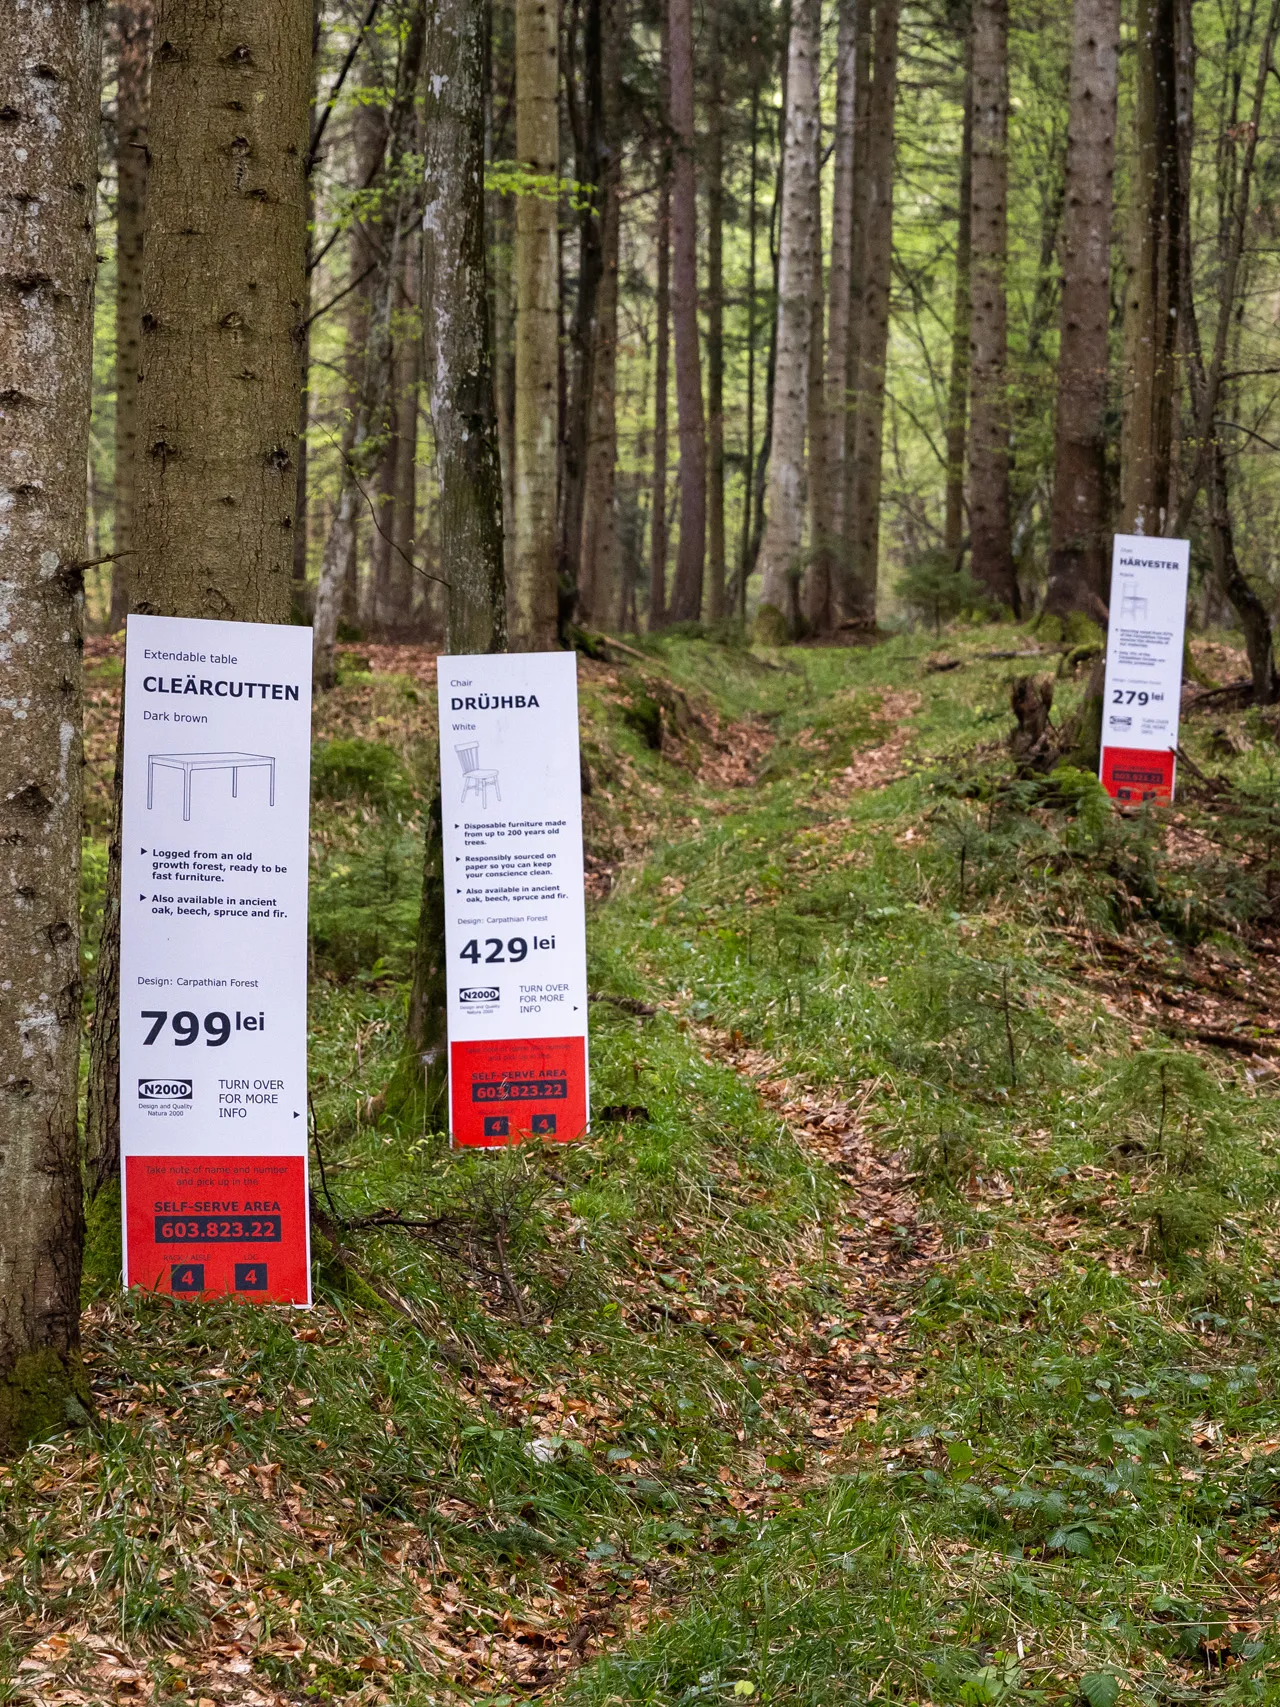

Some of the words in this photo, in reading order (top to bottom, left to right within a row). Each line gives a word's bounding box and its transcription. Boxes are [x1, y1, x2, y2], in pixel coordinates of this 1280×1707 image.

[144, 650, 206, 662] Extendable
[210, 654, 237, 664] table
[143, 675, 299, 700] CLEÄRCUTTEN
[452, 693, 539, 710] DRÜJHBA
[144, 711, 169, 721] Dark
[174, 712, 208, 723] brown
[464, 822, 506, 830] Disposable
[153, 849, 190, 859] Logged
[194, 851, 217, 859] from
[237, 852, 252, 860] old
[152, 861, 189, 871] growth
[193, 862, 226, 872] forest,
[230, 864, 258, 873] ready
[275, 865, 287, 873] be
[152, 872, 172, 880] fast
[175, 873, 224, 882] furniture.
[152, 895, 174, 903] Also
[177, 896, 223, 905] available
[227, 896, 236, 905] in
[239, 898, 277, 906] ancient
[152, 906, 173, 915] oak,
[177, 907, 210, 916] beech,
[214, 909, 248, 917] spruce
[251, 909, 269, 917] and
[273, 910, 287, 918] fir.
[487, 916, 524, 924] Carpathian
[138, 977, 172, 987] Design:
[177, 978, 227, 987] Carpathian
[230, 979, 258, 987] Forest
[464, 991, 496, 999] N2000
[540, 994, 564, 1002] MORE
[145, 1085, 187, 1095] N2000
[219, 1080, 249, 1089] TURN
[253, 1080, 284, 1089] OVER
[477, 1085, 562, 1098] 603.823.22
[219, 1094, 241, 1103] FOR
[246, 1095, 278, 1103] MORE
[219, 1108, 246, 1118] INFO
[492, 1121, 501, 1132] 4
[539, 1120, 548, 1129] 4
[154, 1202, 238, 1212] SELF-SERVE
[244, 1202, 281, 1212] AREA
[162, 1222, 275, 1238] 603.823.22
[182, 1271, 194, 1285] 4
[245, 1270, 257, 1284] 4
